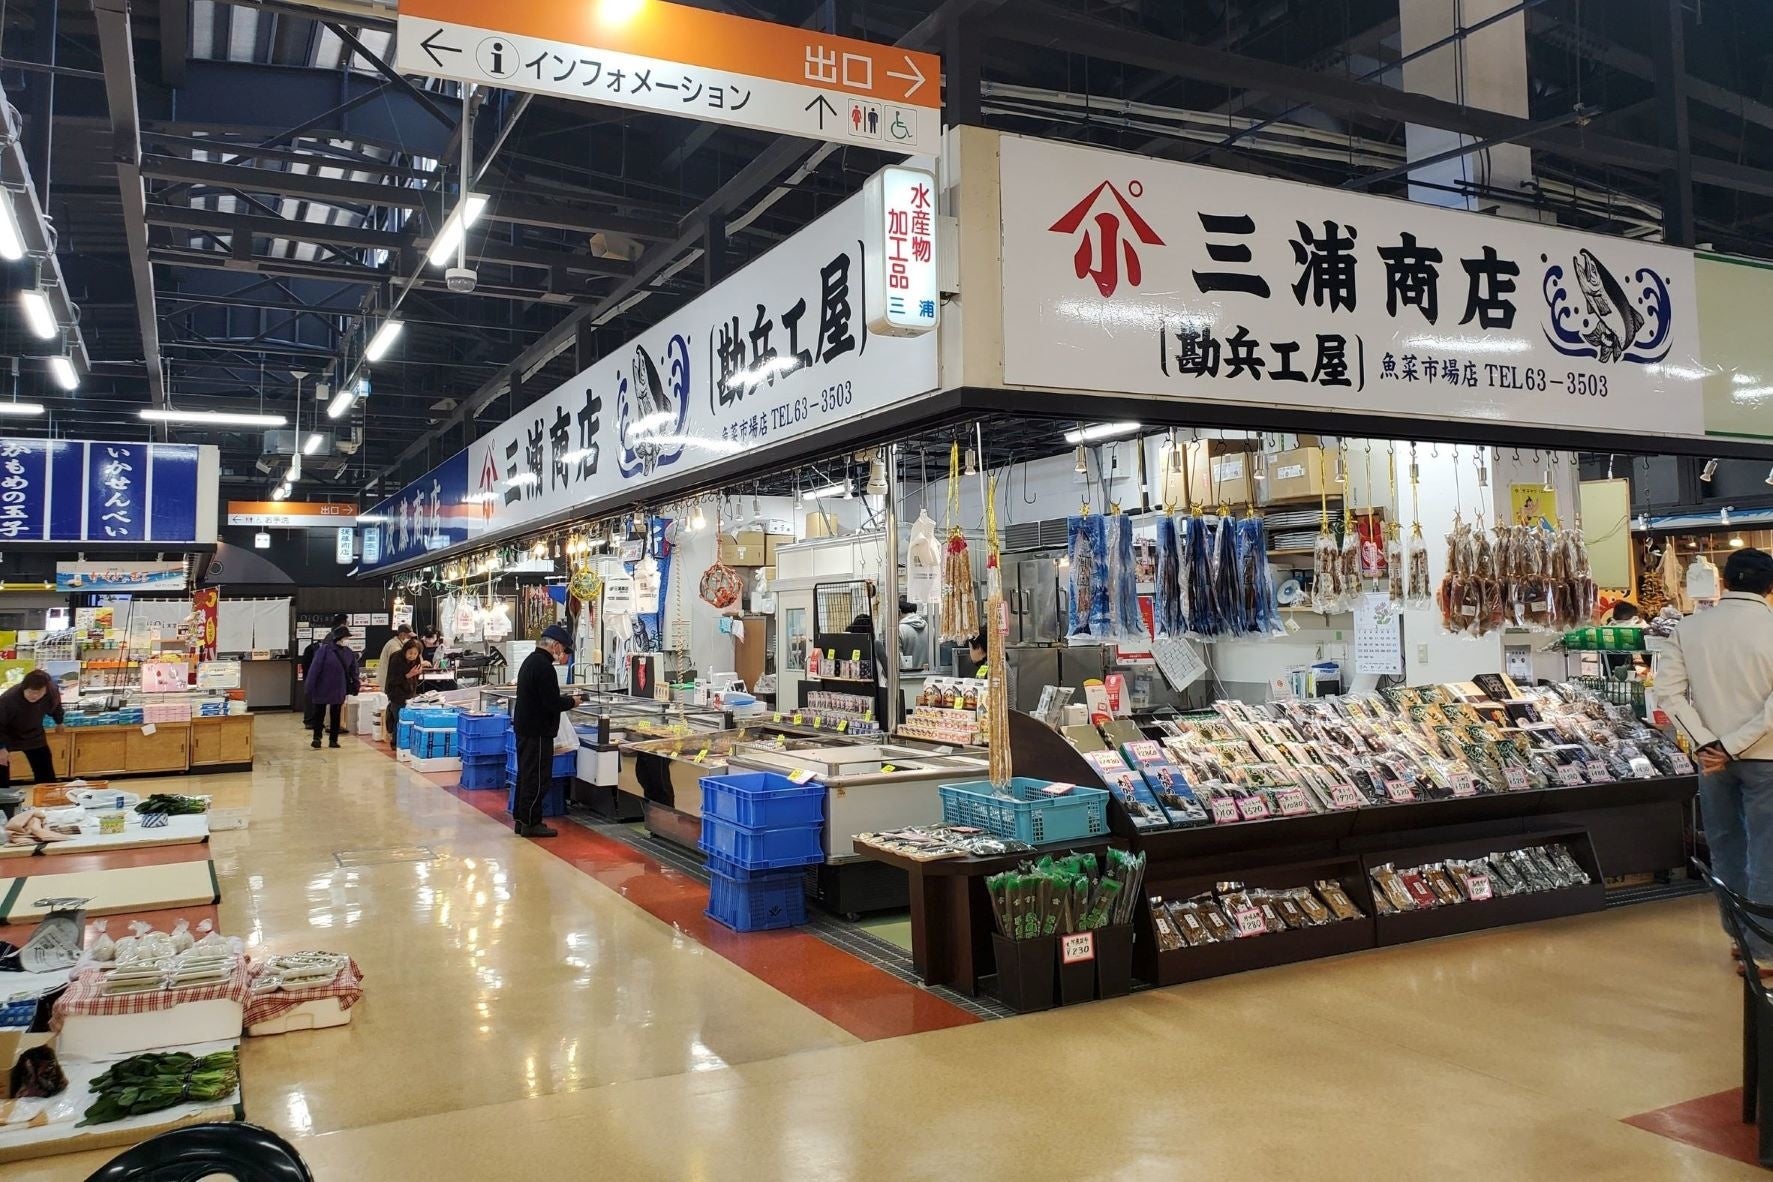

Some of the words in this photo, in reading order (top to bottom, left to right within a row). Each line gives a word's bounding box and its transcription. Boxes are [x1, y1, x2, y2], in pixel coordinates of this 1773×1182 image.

[525, 51, 750, 110] インフォメーション
[805, 46, 872, 90] 出口
[888, 209, 908, 289] 加工品
[911, 183, 931, 263] 水産物
[1192, 211, 1520, 330] 三浦商店
[890, 297, 934, 318] 三浦
[1381, 352, 1478, 387] 魚菜市場店
[505, 388, 602, 507] 三浦商店
[0, 444, 31, 537] かもめの玉子
[102, 447, 132, 537] いかせんべい
[321, 506, 339, 515] 出口
[1066, 945, 1090, 955] ¥230
